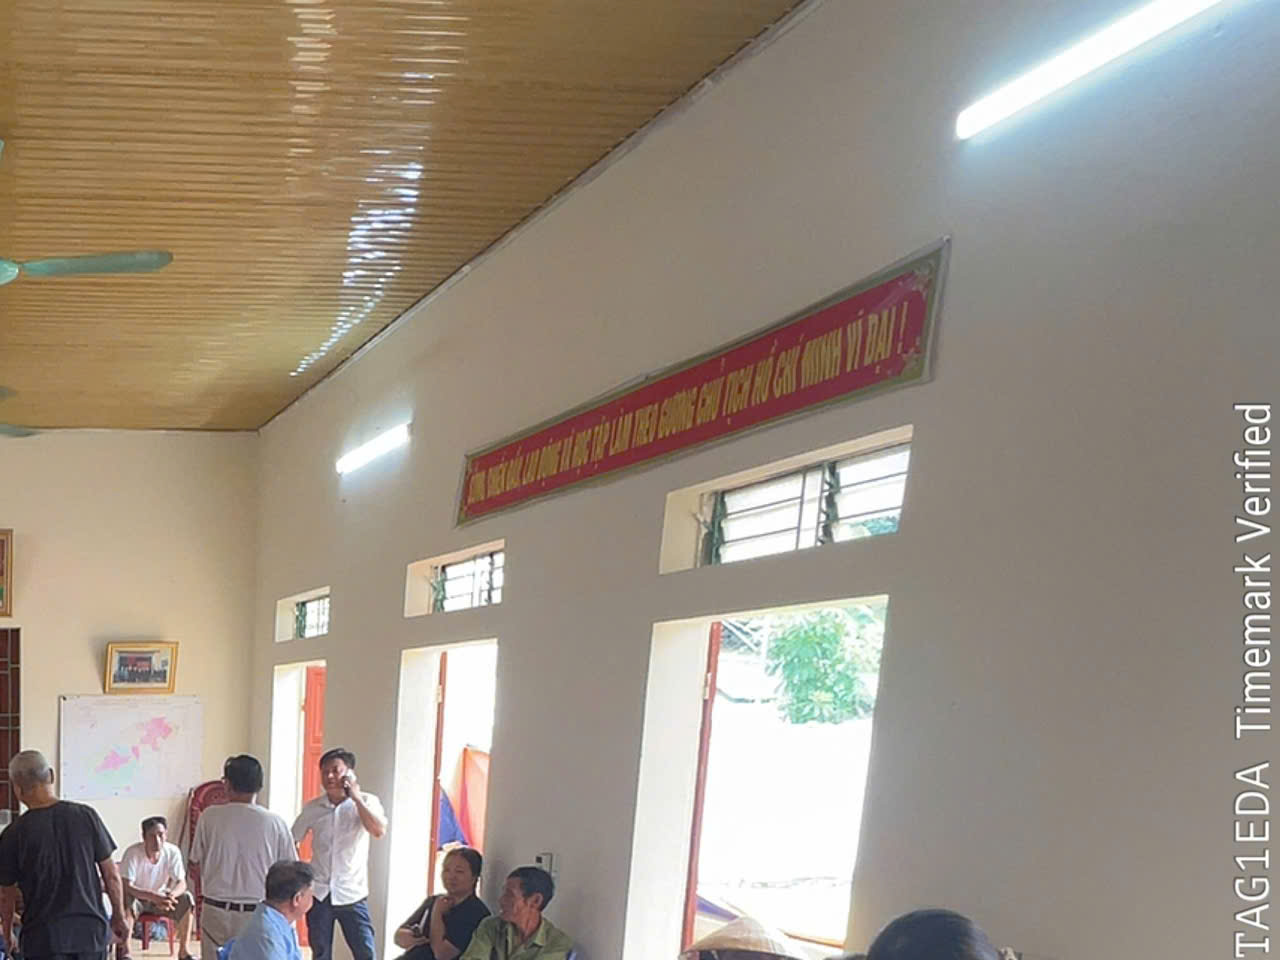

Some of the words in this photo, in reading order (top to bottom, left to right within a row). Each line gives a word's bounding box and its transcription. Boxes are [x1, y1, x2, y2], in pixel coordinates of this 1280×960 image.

[750, 339, 778, 407] HỒ
[772, 335, 804, 399] CHÍ
[800, 327, 842, 389] MINH
[846, 309, 864, 373] VĨ
[863, 305, 897, 374] ĐẠI
